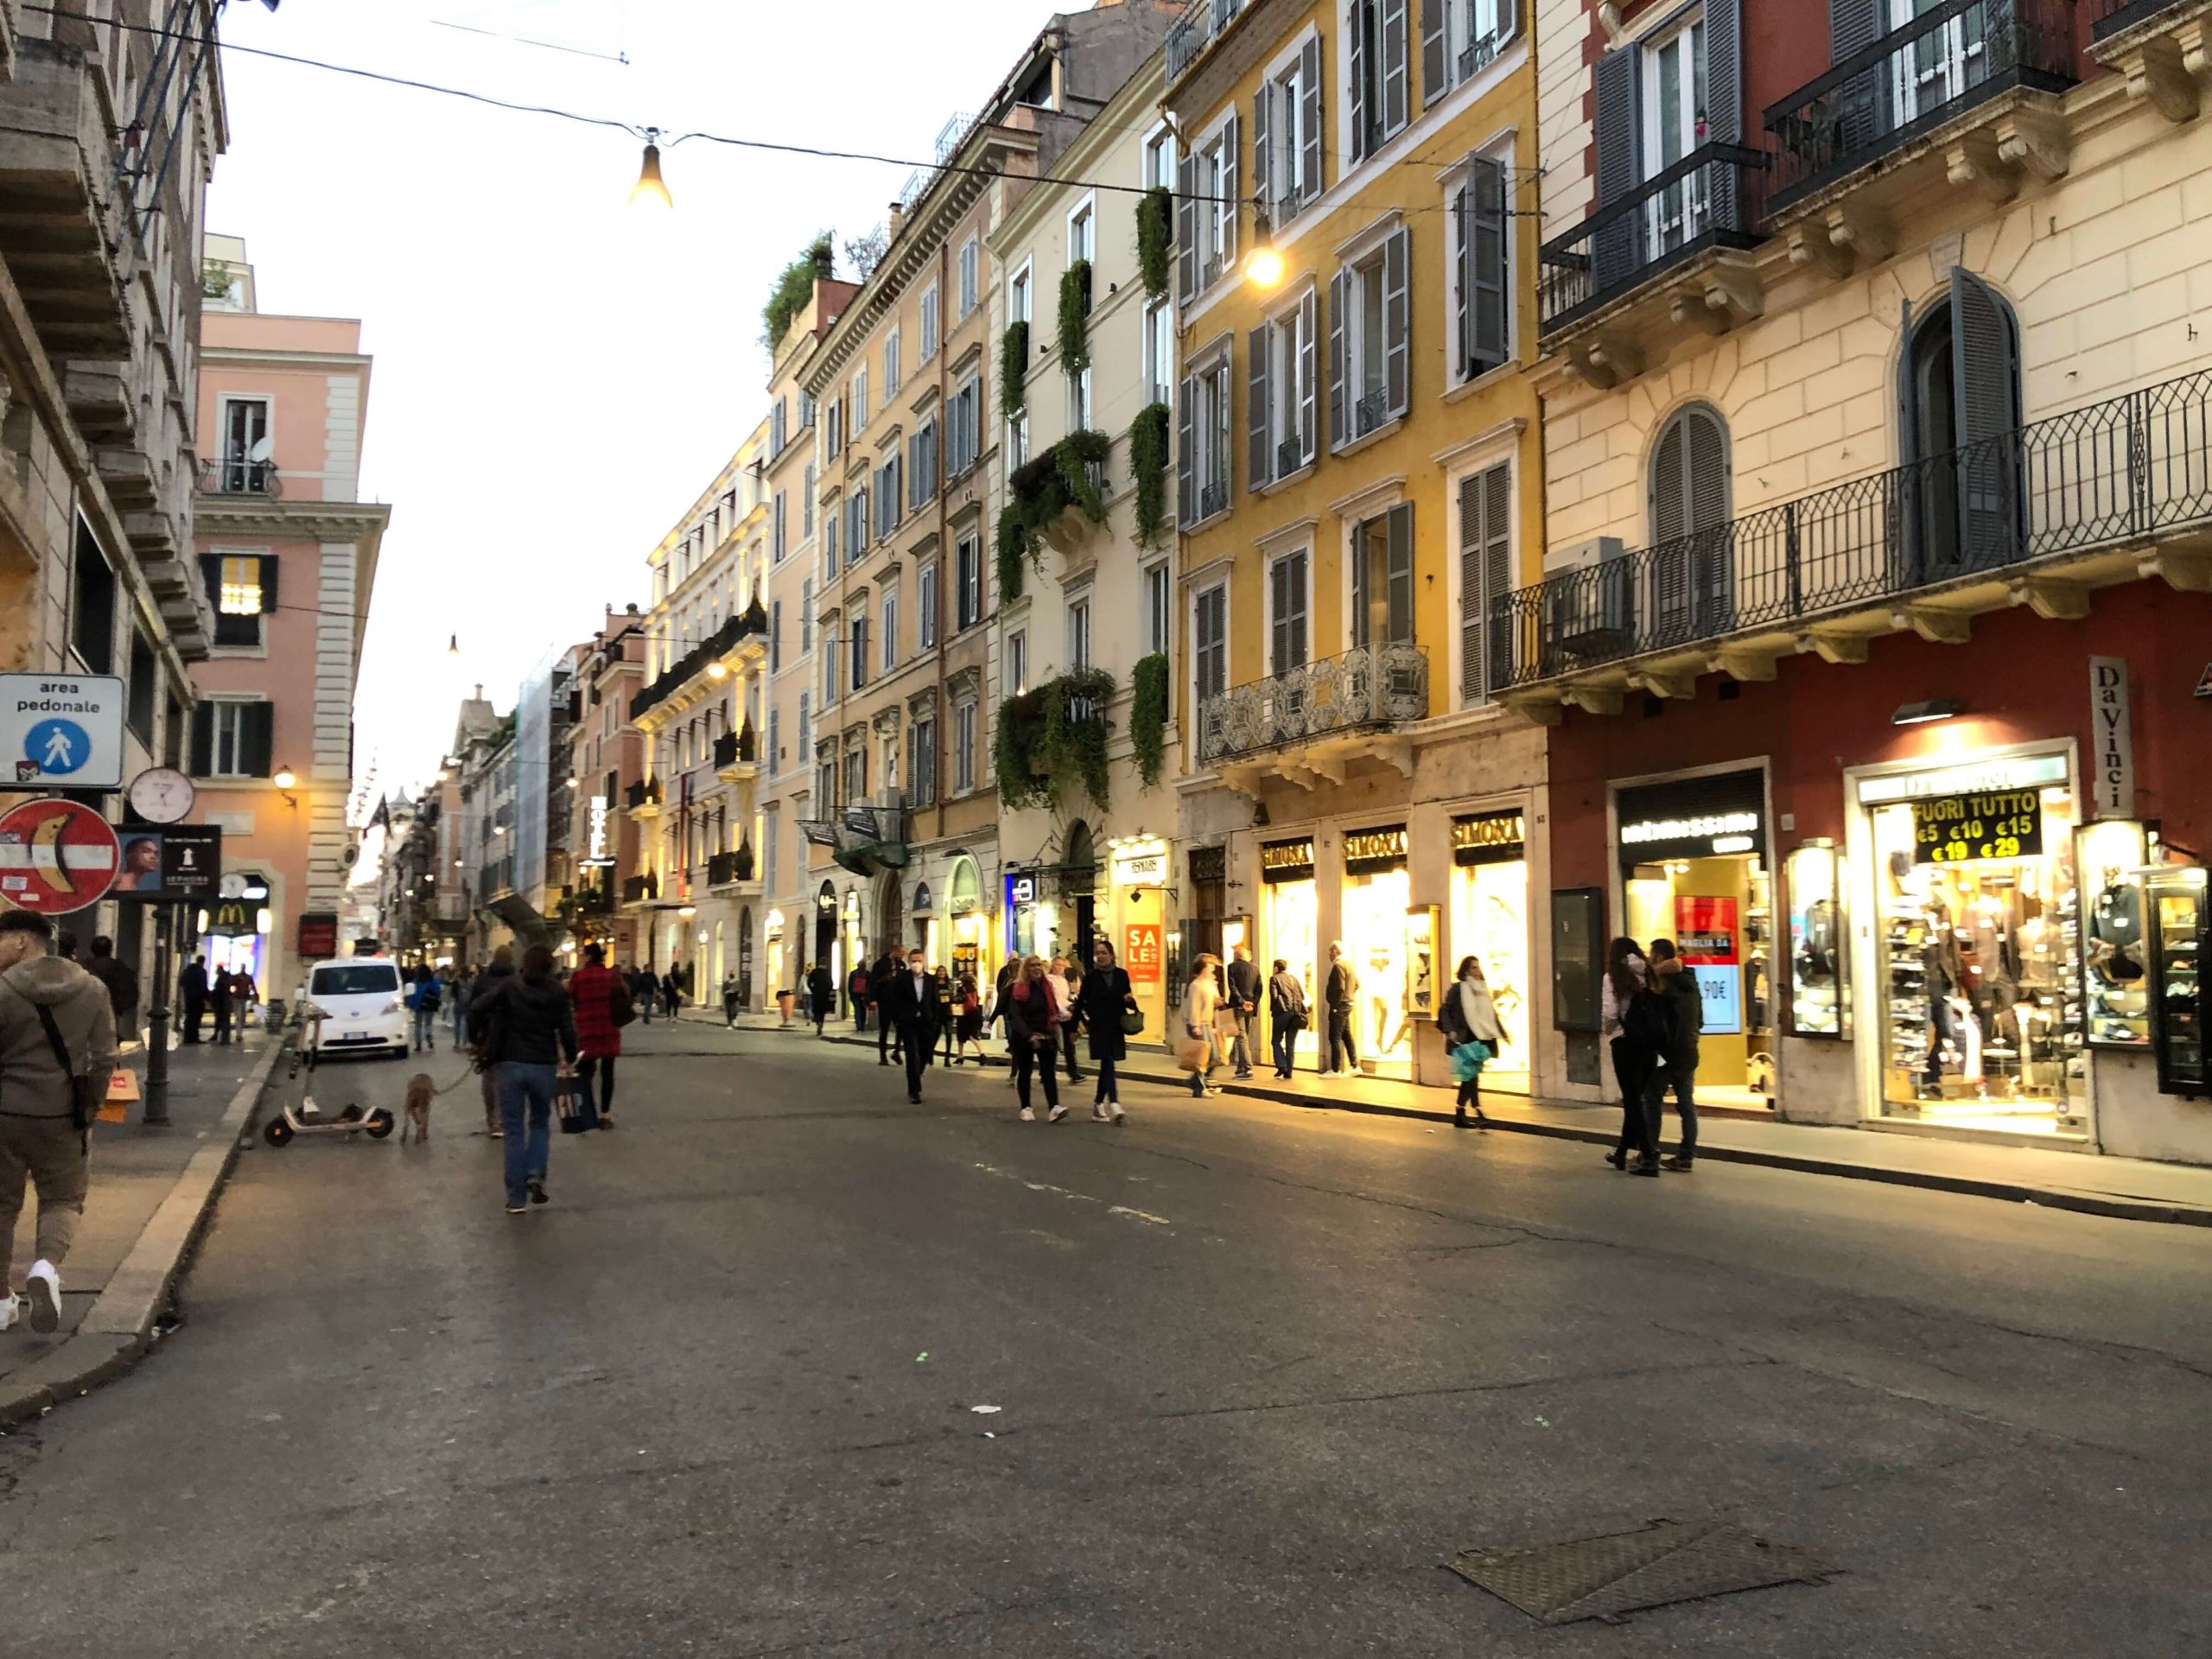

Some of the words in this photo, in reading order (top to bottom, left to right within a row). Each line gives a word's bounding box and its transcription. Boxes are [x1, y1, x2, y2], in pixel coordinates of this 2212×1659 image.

[40, 683, 79, 693] area
[17, 698, 100, 713] pedonale
[1912, 798, 1965, 823] FUORI
[1969, 791, 2037, 818] TUTTO
[590, 796, 607, 859] OTEL
[1451, 817, 1521, 847] SIMONA
[1917, 823, 1939, 842] €5
[1949, 820, 1983, 840] €10
[1996, 815, 2032, 836] €15
[1342, 833, 1403, 860] SIMONA
[1931, 841, 1968, 862] €19
[1980, 836, 2020, 859] €29
